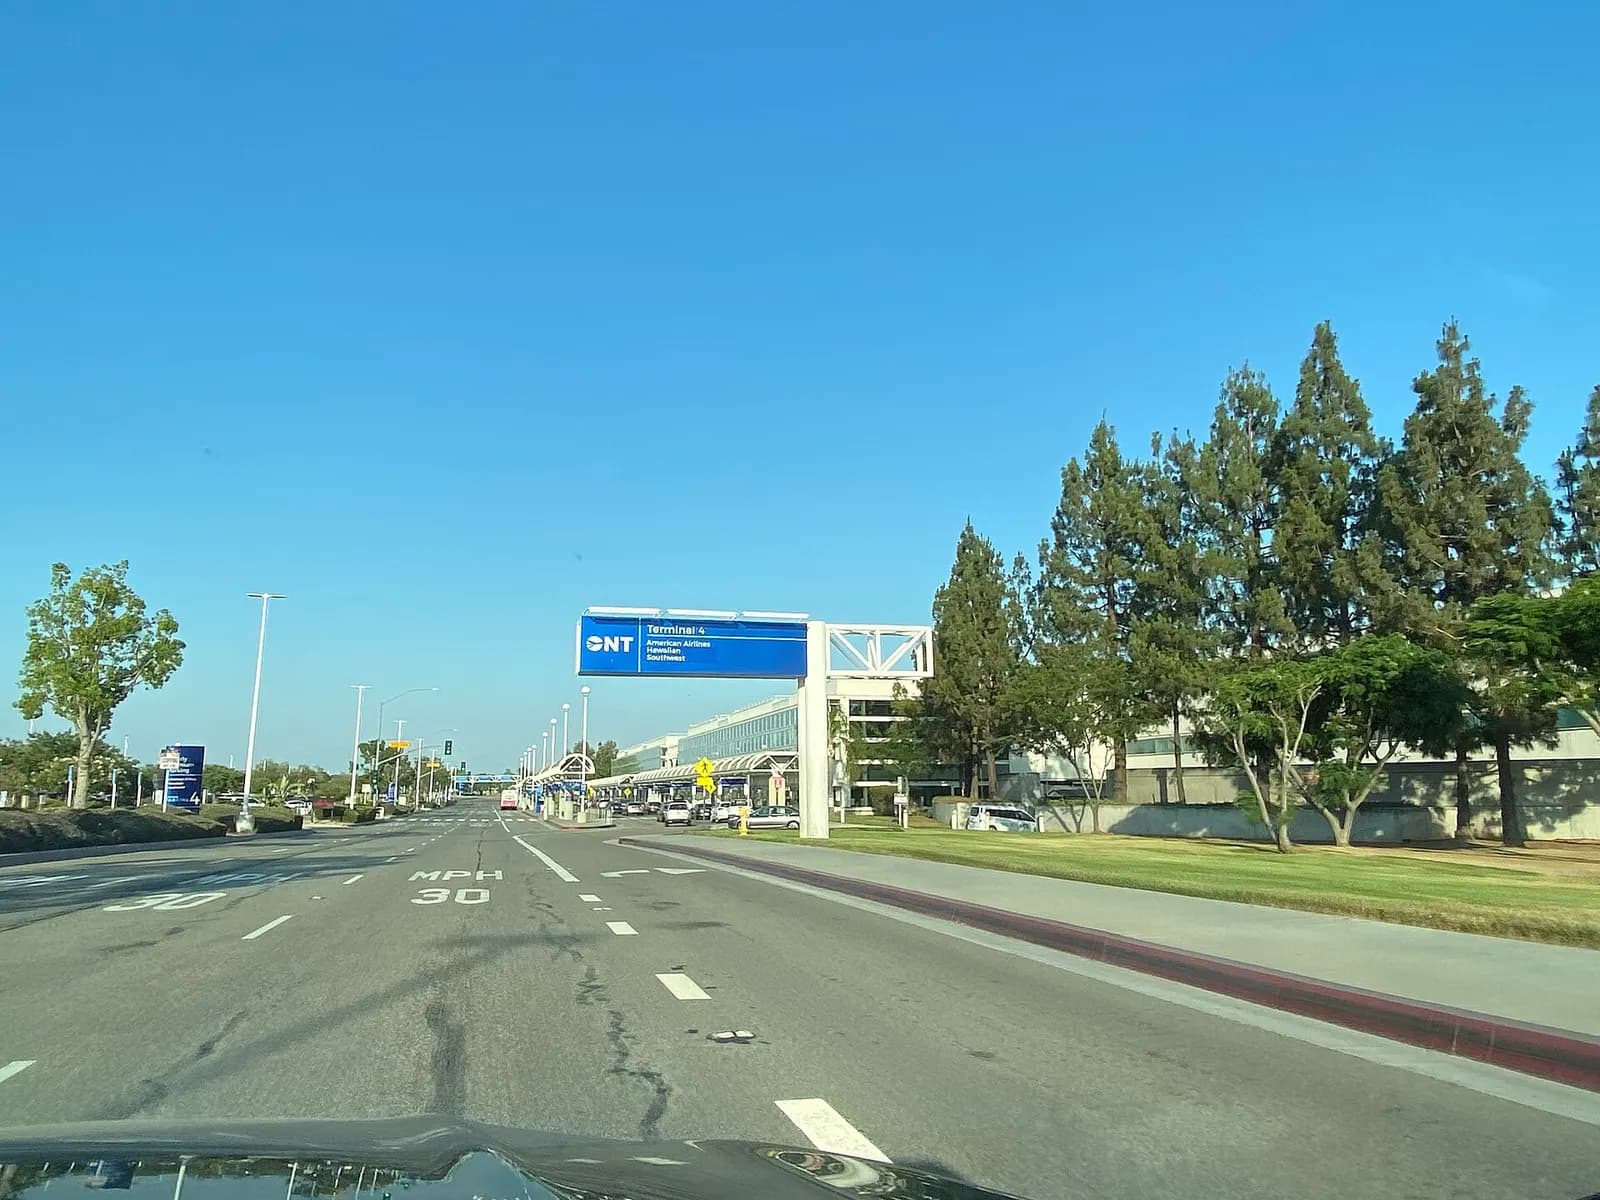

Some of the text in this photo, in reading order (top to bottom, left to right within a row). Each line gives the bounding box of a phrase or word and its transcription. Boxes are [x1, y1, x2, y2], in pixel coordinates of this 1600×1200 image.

[647, 625, 705, 635] Terminal 4
[586, 636, 634, 652] ONT
[683, 640, 711, 648] Airlines
[646, 654, 686, 662] Southwest
[190, 791, 200, 805] 4
[408, 870, 503, 881] MPH
[103, 892, 227, 912] 30
[410, 888, 491, 905] 30
